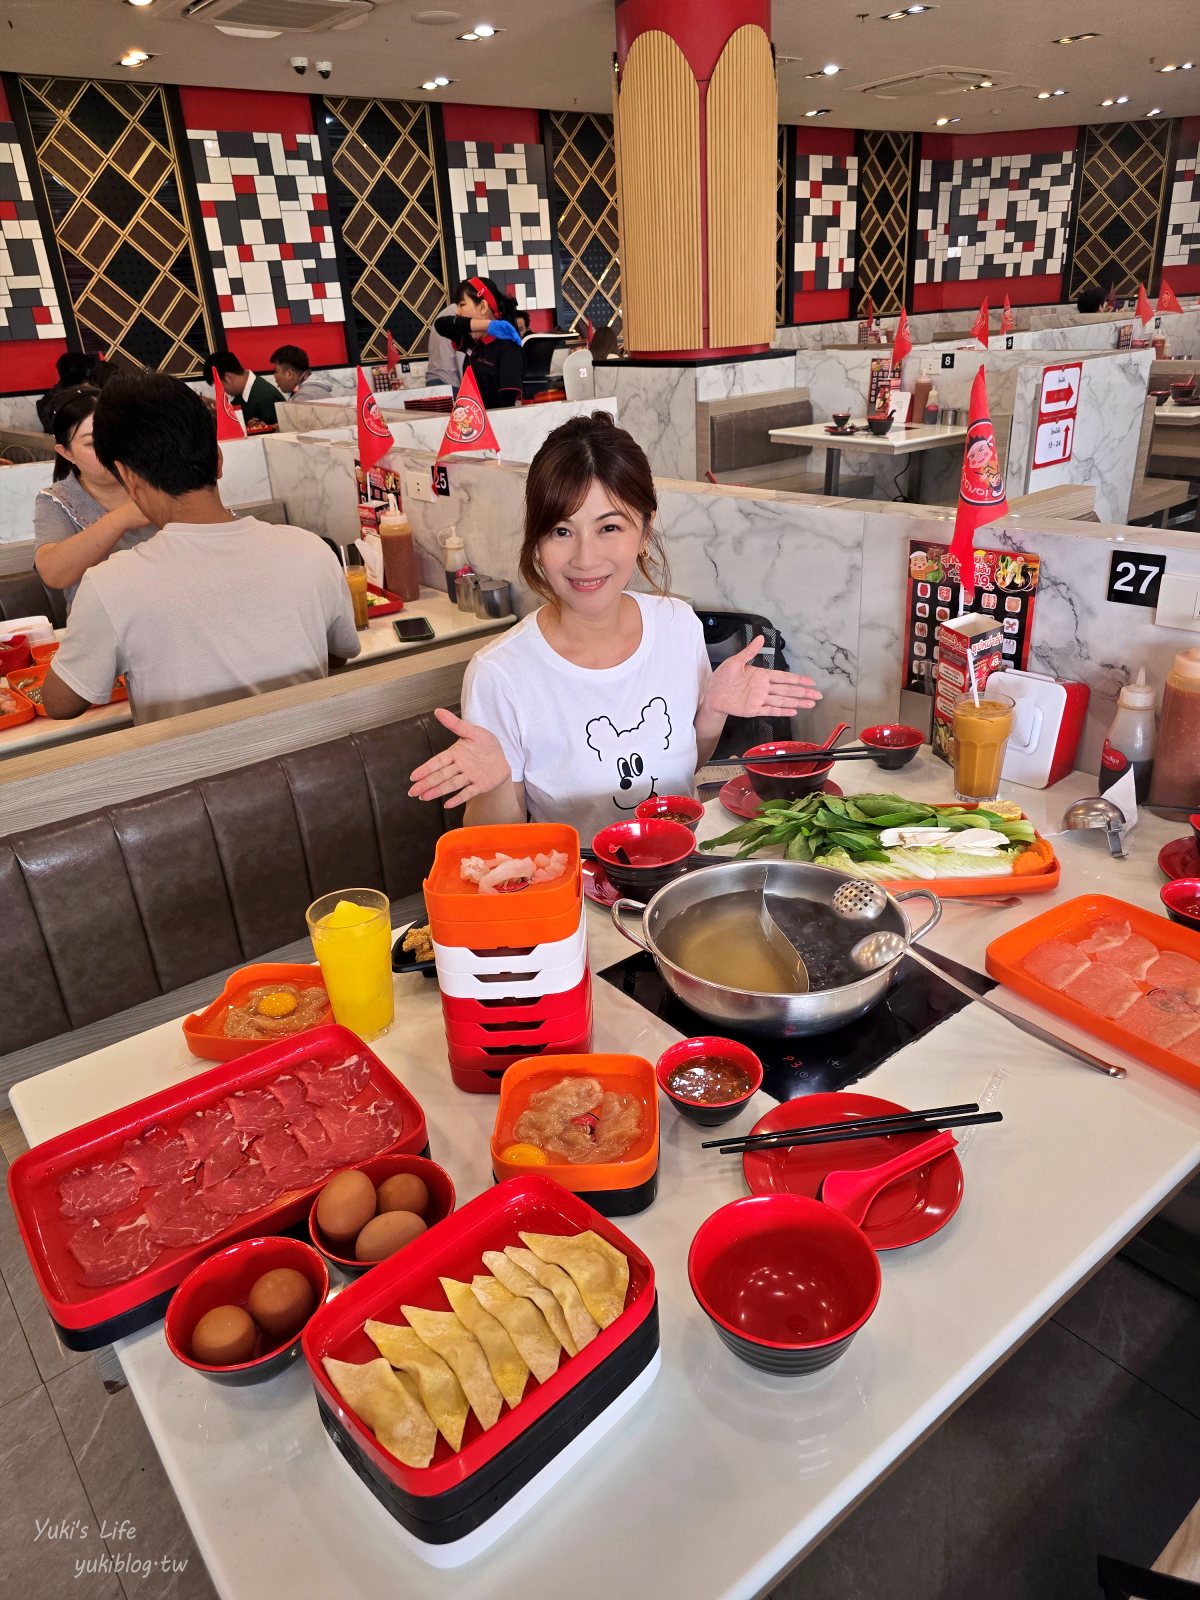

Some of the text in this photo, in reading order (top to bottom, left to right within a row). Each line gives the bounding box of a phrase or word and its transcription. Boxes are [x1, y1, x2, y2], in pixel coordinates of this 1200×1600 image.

[944, 356, 951, 366] 8
[435, 472, 447, 489] 25
[1113, 561, 1160, 595] 27
